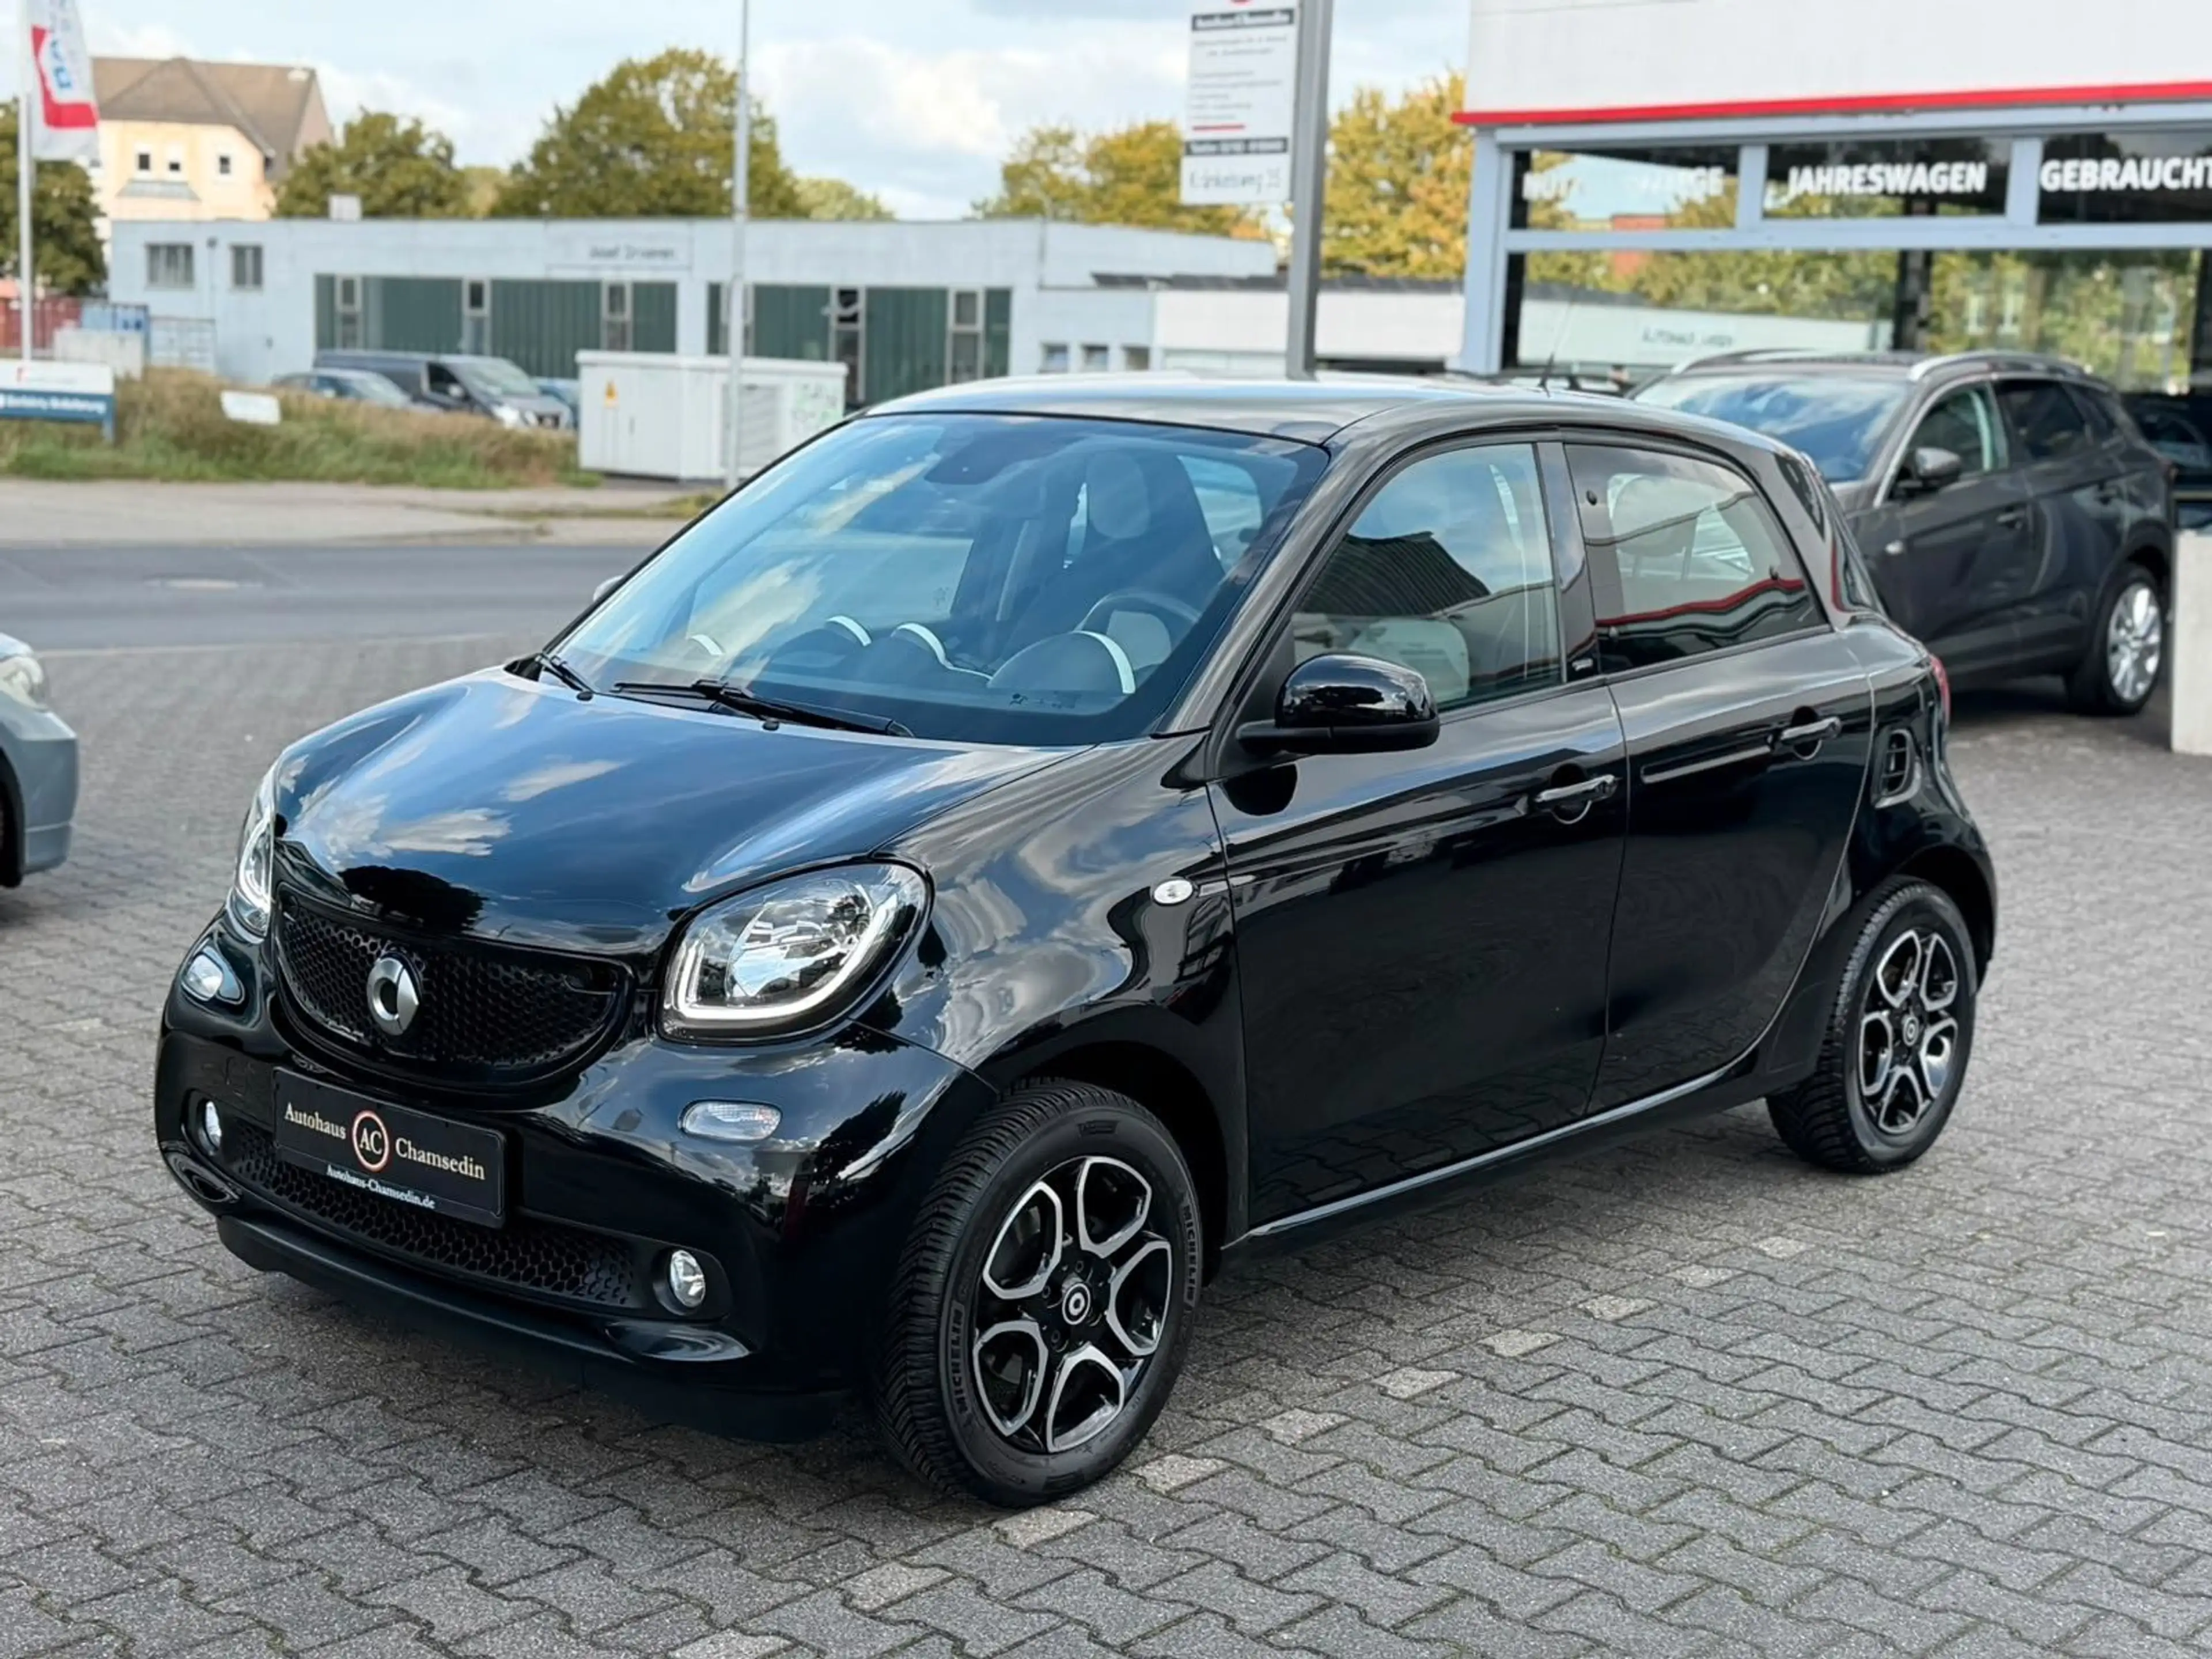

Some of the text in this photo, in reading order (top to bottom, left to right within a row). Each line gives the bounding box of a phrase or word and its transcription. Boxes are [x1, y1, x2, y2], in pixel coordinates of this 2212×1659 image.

[1787, 162, 1987, 196] JAHRESWAGEN
[284, 1102, 486, 1180] Autohaus AC Chamsedin
[325, 1164, 435, 1210] Autohaus-Chamsedin.de
[950, 1309, 968, 1414] MICHELIN
